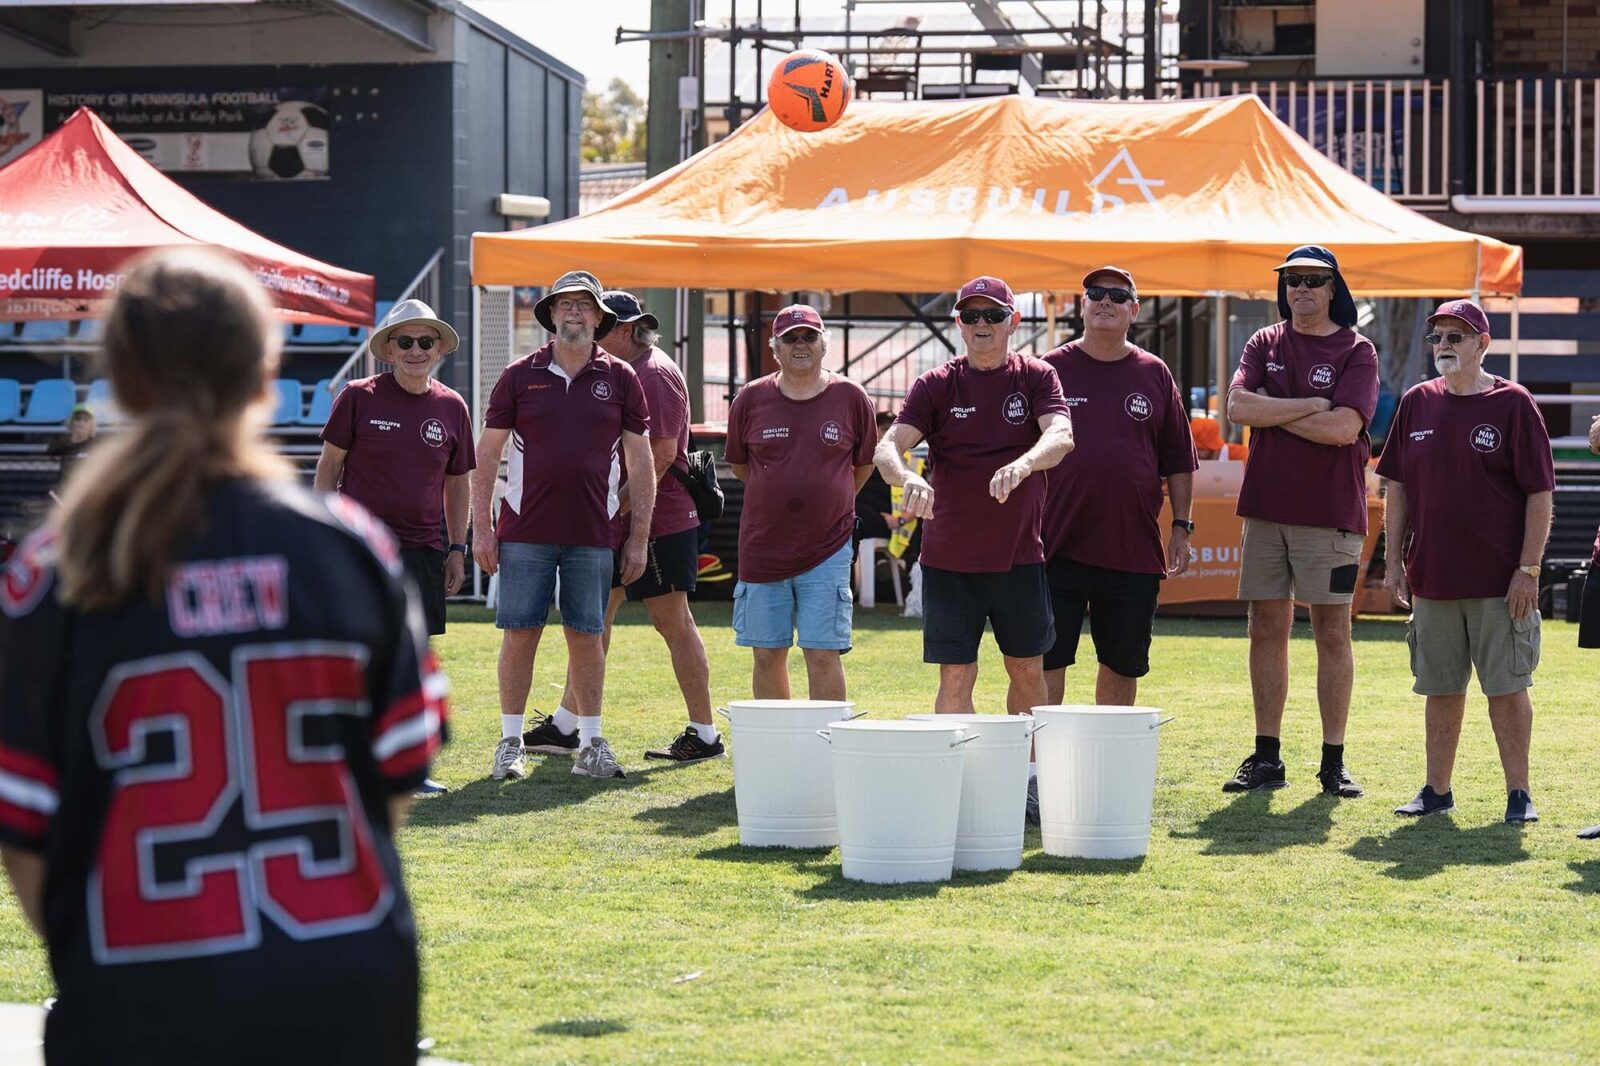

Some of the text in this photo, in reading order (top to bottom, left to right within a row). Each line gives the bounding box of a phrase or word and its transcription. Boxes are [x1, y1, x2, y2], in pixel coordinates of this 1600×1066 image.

[820, 61, 834, 98] HART
[48, 92, 279, 106] HISTORY OF PENINSULA FOOTBALL
[218, 110, 244, 122] Park
[815, 186, 1126, 217] AUSBUILD
[1316, 369, 1331, 377] MAN
[1312, 375, 1331, 384] WALK
[1132, 398, 1147, 408] MAN
[1130, 405, 1148, 415] WALK
[427, 424, 442, 434] MAN
[826, 426, 838, 434] MAN
[425, 431, 443, 441] WALK
[824, 432, 839, 441] WALK
[1478, 430, 1495, 440] MAN
[1475, 436, 1495, 448] WALK
[1200, 566, 1237, 579] journey
[85, 640, 396, 967] 25
